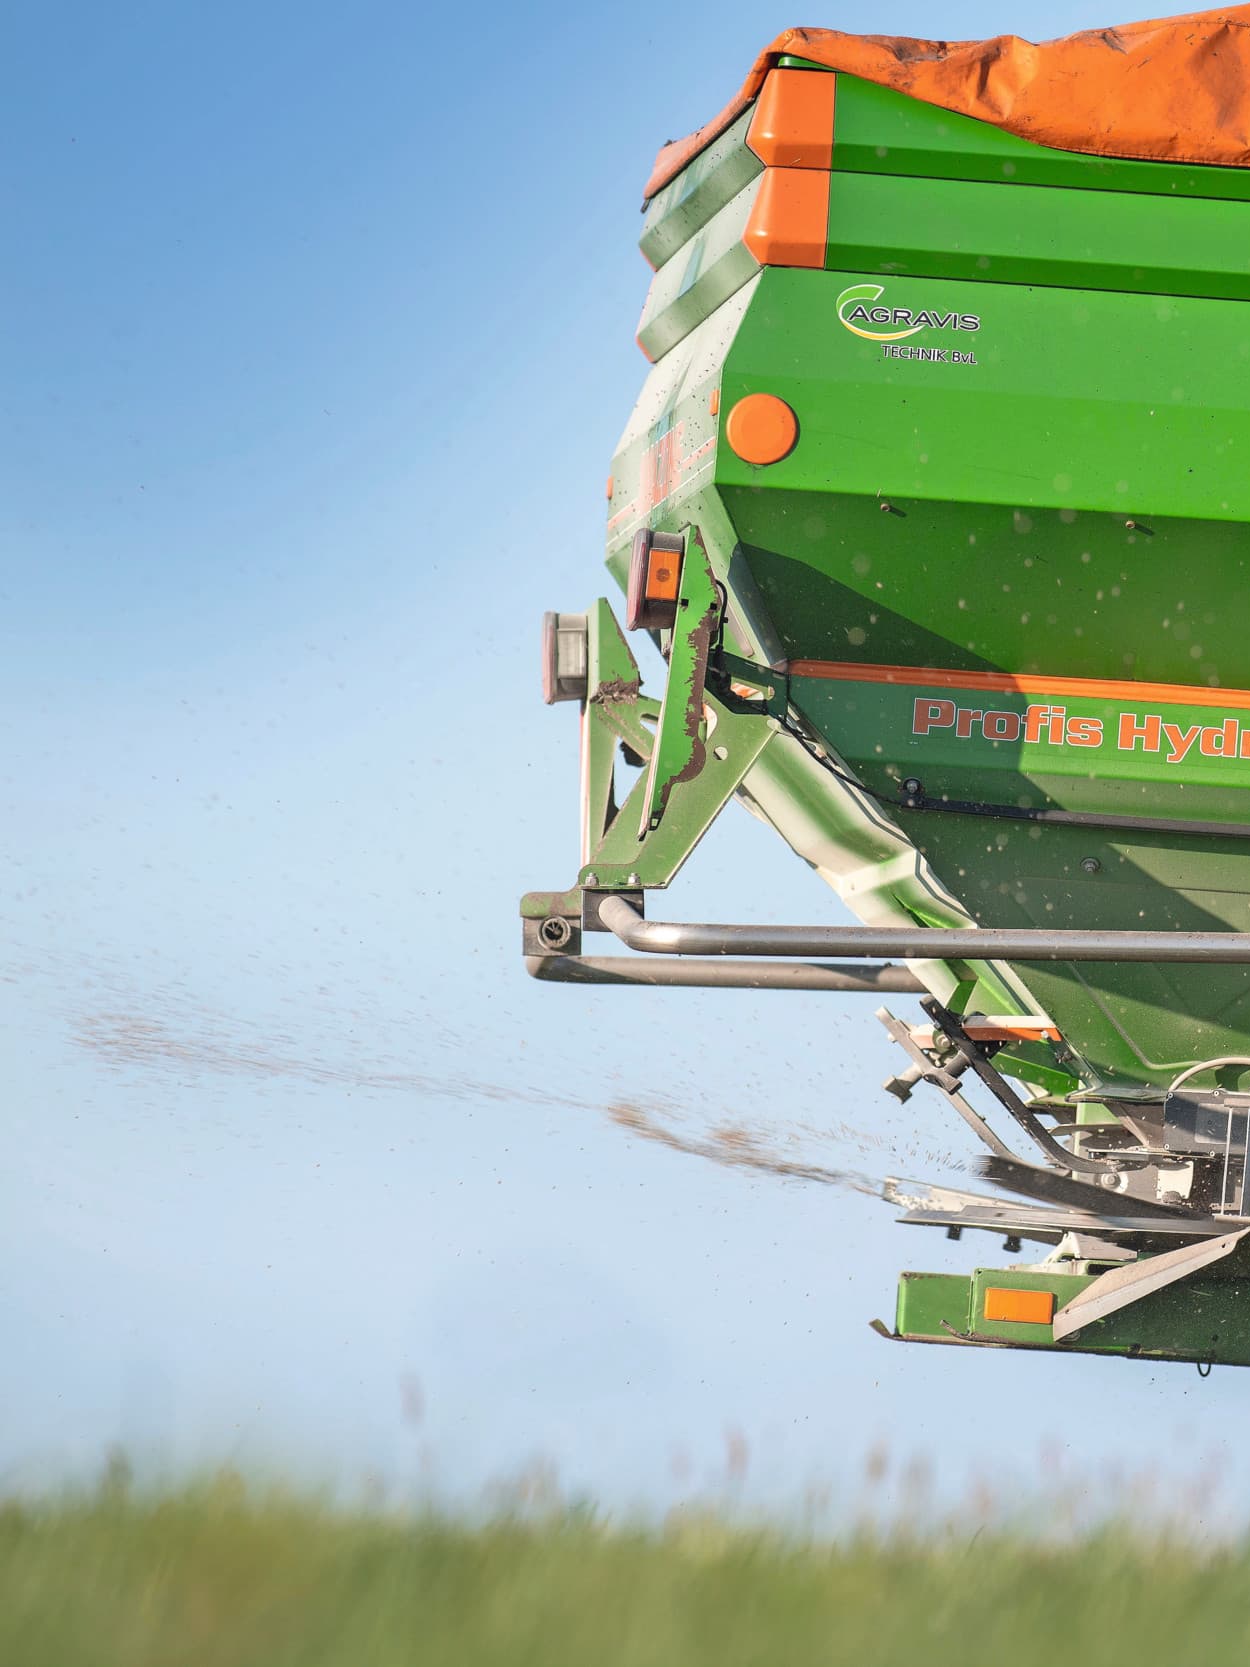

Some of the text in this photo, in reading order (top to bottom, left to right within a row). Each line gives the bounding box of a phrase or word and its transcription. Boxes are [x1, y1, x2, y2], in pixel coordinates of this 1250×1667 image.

[848, 305, 980, 331] AGRAVIS
[881, 344, 977, 364] TECHNIK BvL
[912, 698, 1104, 748] Profis
